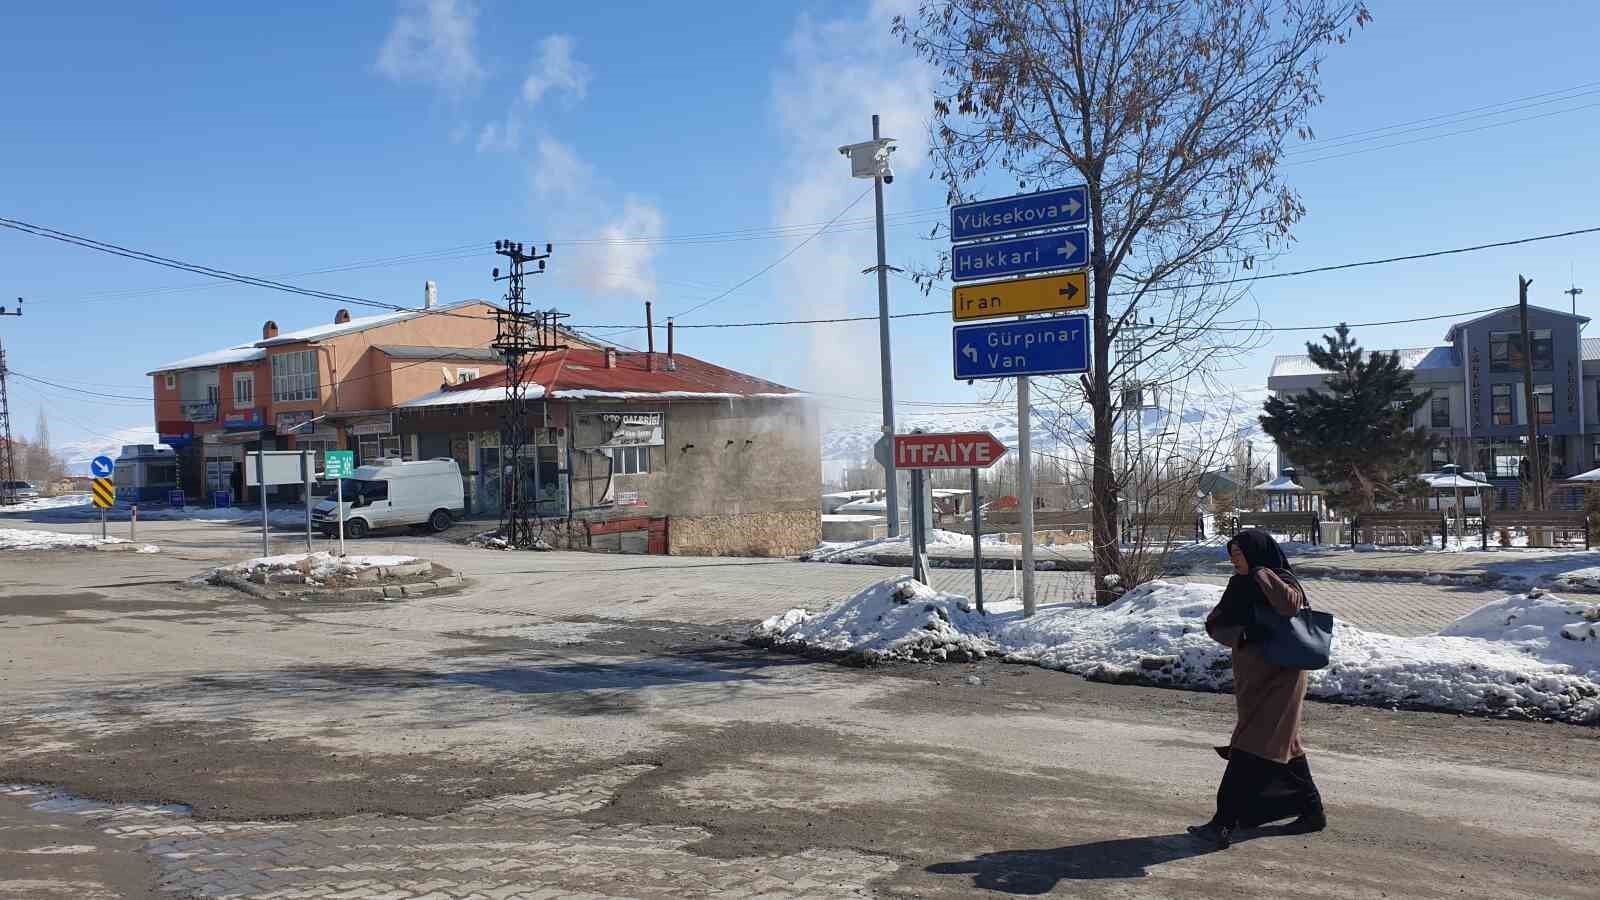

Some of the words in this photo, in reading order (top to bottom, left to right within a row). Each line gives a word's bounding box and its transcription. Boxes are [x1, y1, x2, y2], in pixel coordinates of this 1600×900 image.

[958, 205, 1057, 230] Yüksekova
[960, 247, 1040, 271] Hakkari
[959, 293, 1001, 312] İran
[988, 329, 1080, 349] Gürpınar
[988, 353, 1026, 369] Van
[900, 439, 991, 463] İTFAİYE
